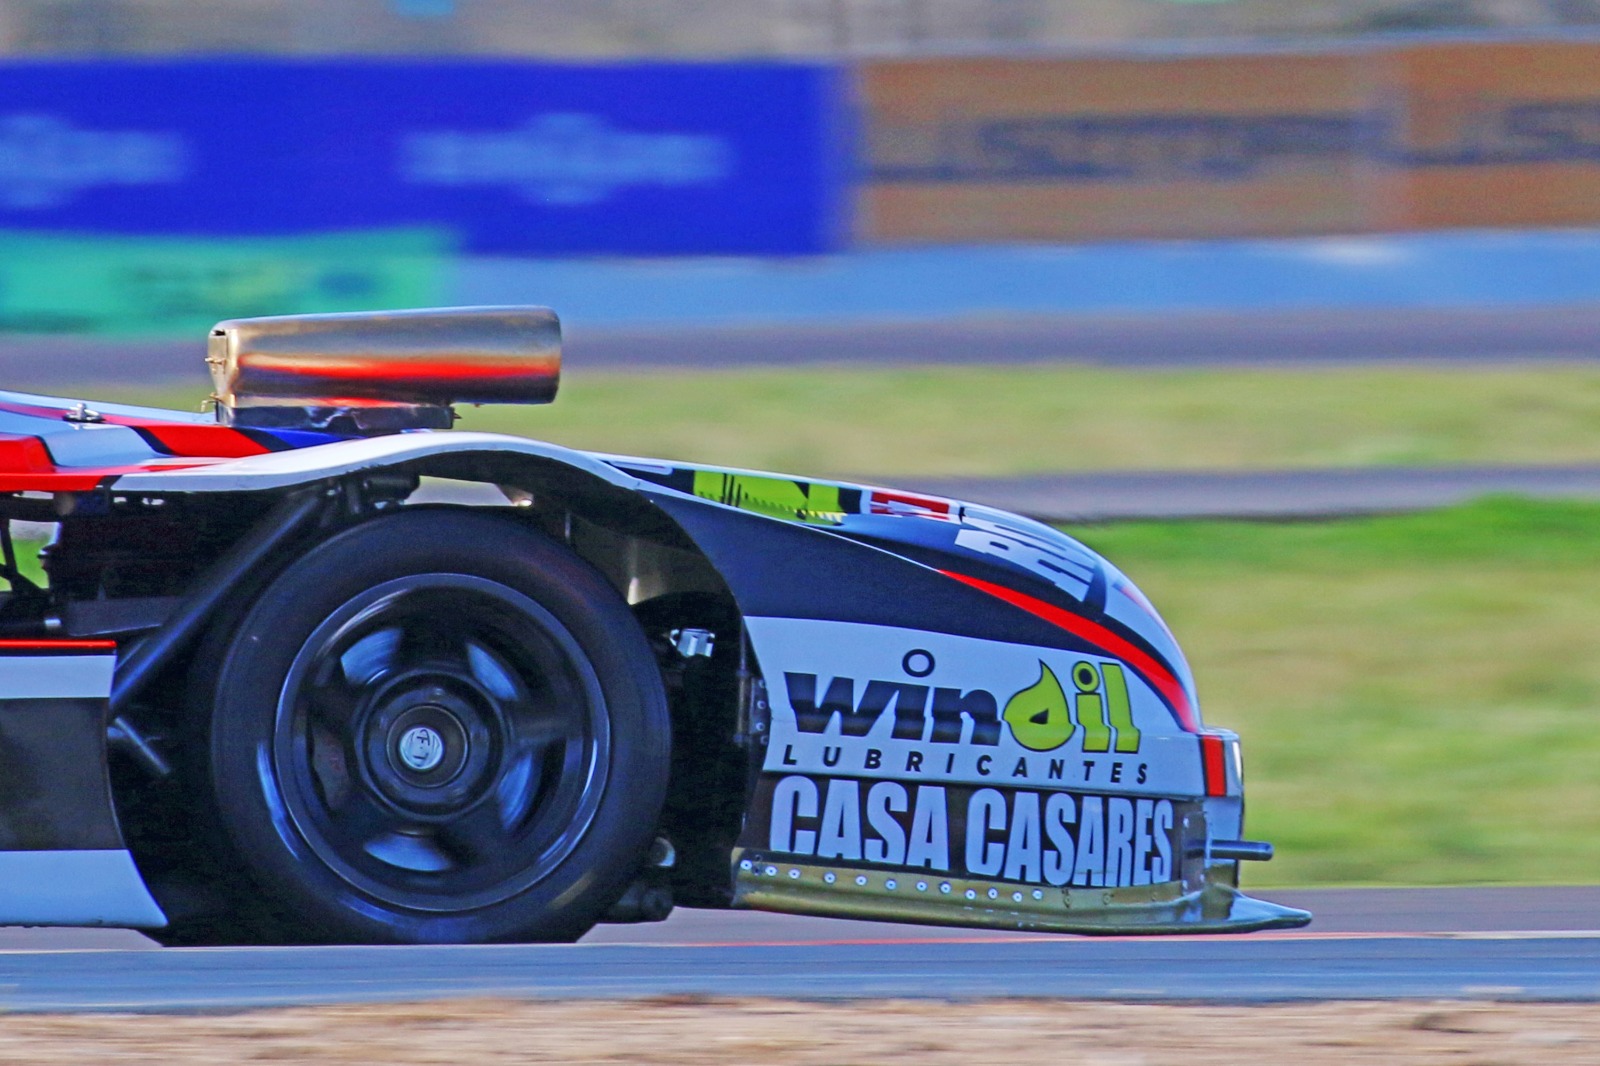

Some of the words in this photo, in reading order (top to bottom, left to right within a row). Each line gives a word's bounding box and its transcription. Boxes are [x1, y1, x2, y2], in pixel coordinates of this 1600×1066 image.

[782, 744, 1148, 784] LUBRICANTES
[770, 776, 949, 870] CASA
[965, 788, 1173, 886] CASARES
